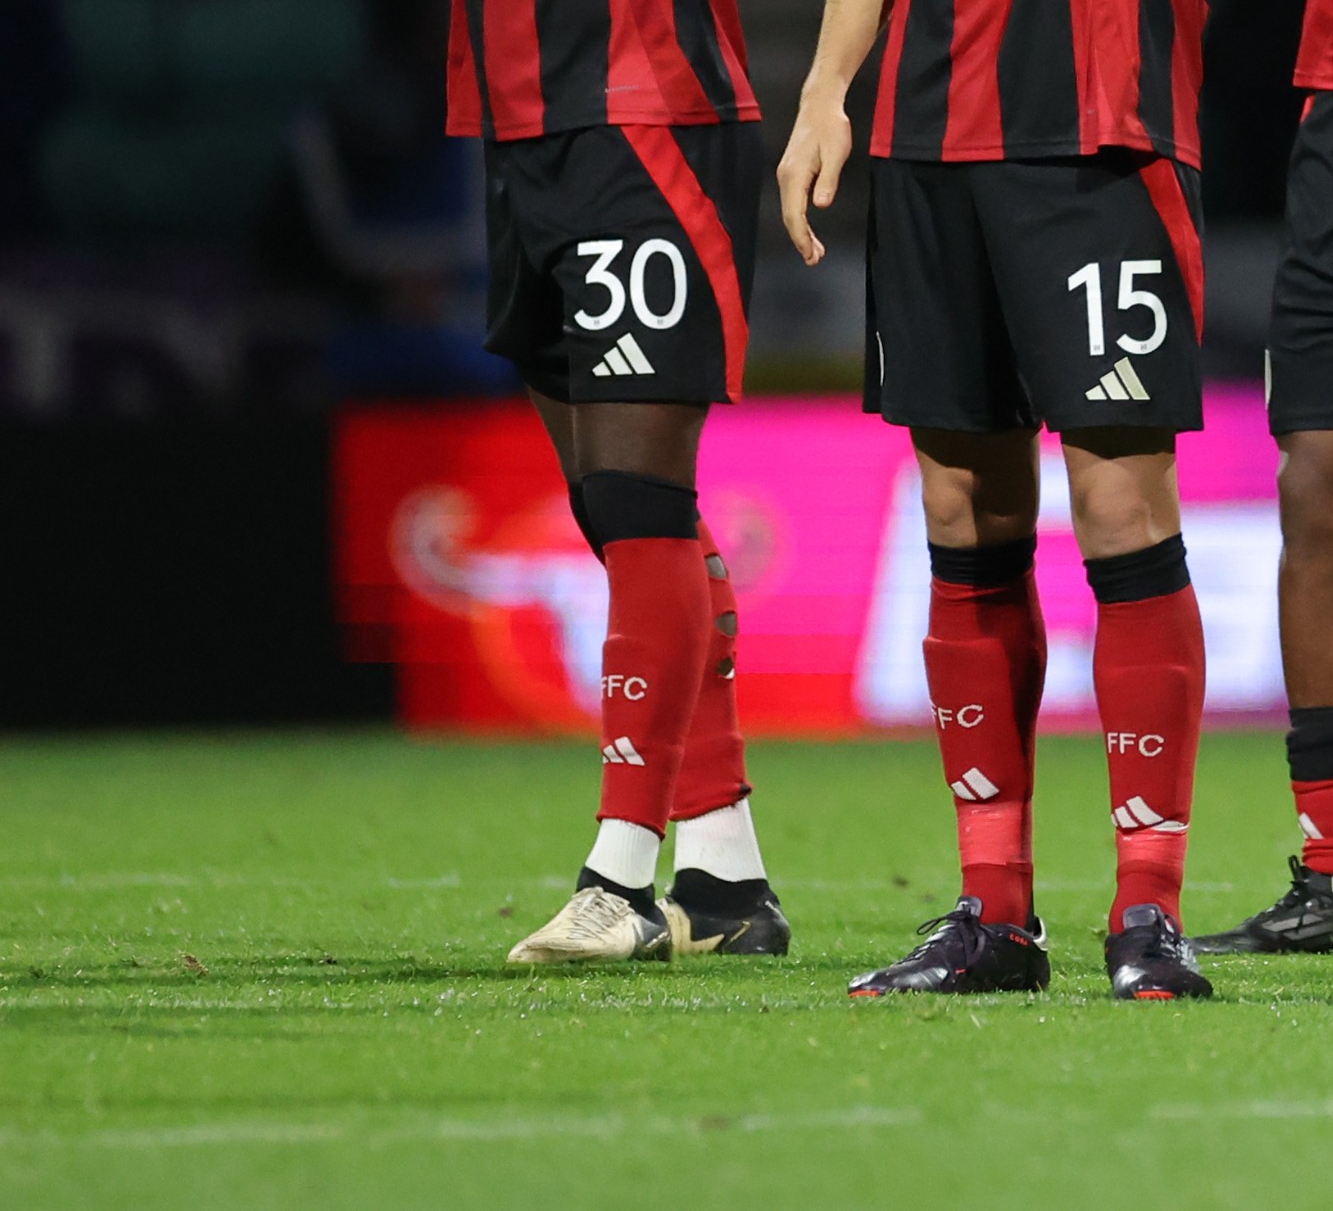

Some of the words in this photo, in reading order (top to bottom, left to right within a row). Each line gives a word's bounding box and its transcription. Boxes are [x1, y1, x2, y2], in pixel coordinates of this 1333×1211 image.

[573, 238, 687, 330] 30
[1067, 259, 1168, 356] 15
[931, 700, 984, 728] FC
[1107, 732, 1165, 757] FFC
